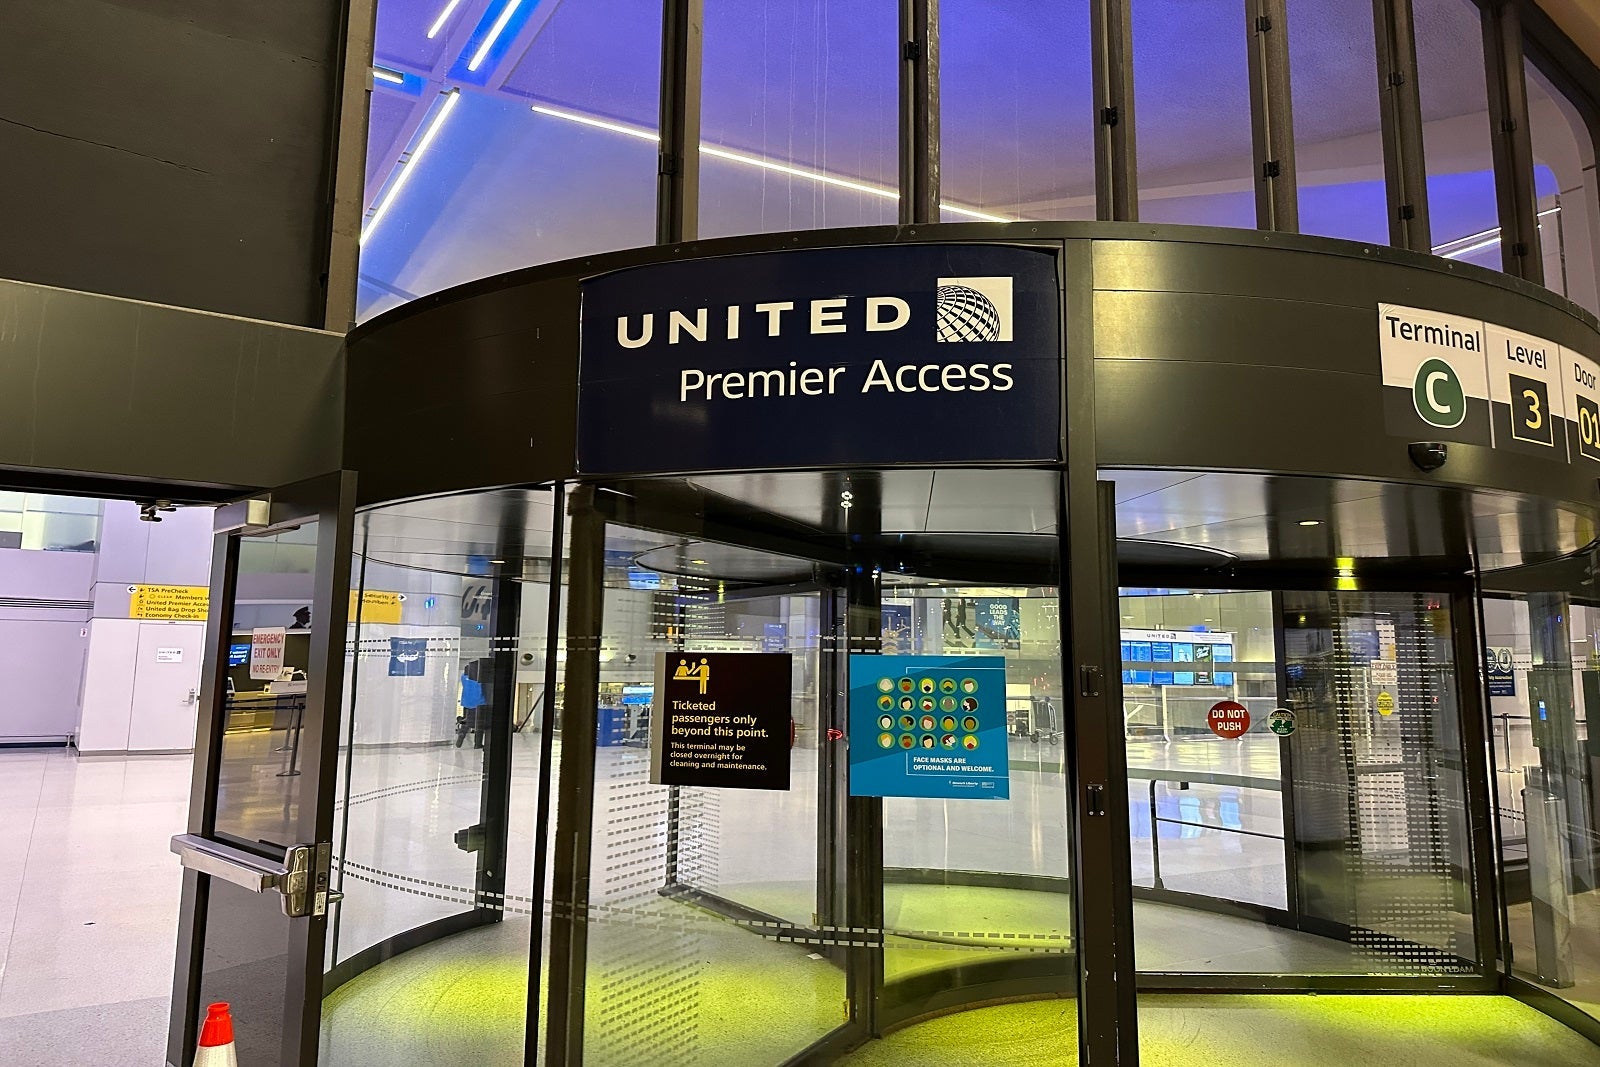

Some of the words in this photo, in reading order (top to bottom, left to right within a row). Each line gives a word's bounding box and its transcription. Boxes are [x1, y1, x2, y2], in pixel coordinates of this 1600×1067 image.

[617, 296, 911, 349] UNITED
[1385, 316, 1481, 352] Terminal
[1506, 339, 1547, 370] Level
[680, 361, 846, 402] Premier
[861, 359, 1014, 393] Access
[1574, 362, 1596, 391] Door
[1425, 371, 1451, 414] C
[1522, 389, 1542, 430] 3
[1580, 407, 1600, 449] 01
[253, 633, 285, 644] EMERGENCY
[254, 648, 266, 658] EXIT
[267, 648, 281, 658] ONLY
[252, 665, 259, 673] NO
[260, 665, 280, 673] RE-ENTRY
[672, 701, 716, 711] Ticketed
[672, 714, 730, 725] passengers
[733, 715, 757, 726] only
[1212, 710, 1225, 719] DO
[1227, 710, 1245, 719] NOT
[671, 726, 711, 737] beyond
[714, 727, 733, 737] this
[737, 727, 769, 739] point.
[1217, 722, 1242, 731] PUSH
[687, 742, 717, 750] terminal
[718, 744, 734, 752] may
[670, 751, 693, 759] closed
[694, 752, 730, 761] overnight
[670, 760, 699, 769] cleaning
[717, 763, 767, 771] maintenance.
